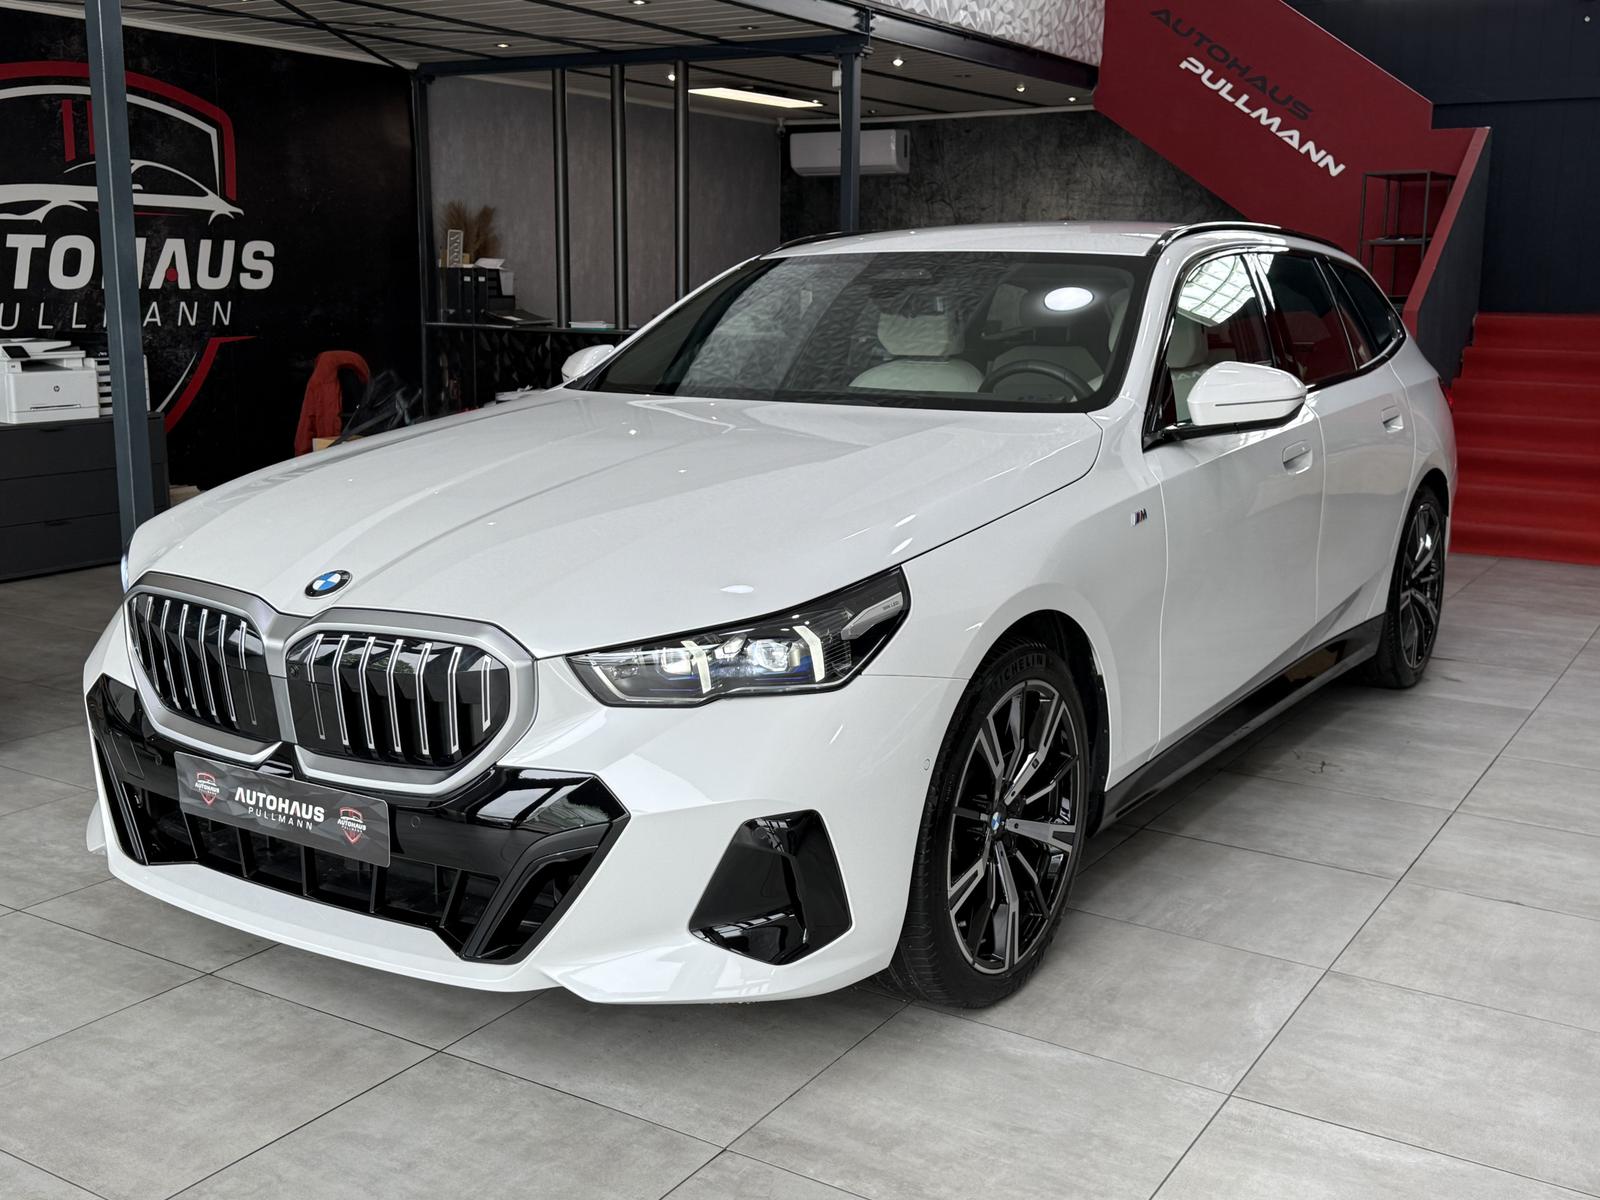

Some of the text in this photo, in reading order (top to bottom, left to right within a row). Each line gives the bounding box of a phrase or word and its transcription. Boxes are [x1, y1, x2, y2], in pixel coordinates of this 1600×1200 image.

[1151, 9, 1313, 121] AUTOHAUS
[1179, 56, 1346, 177] PULLMANN
[0, 301, 232, 331] ULLANN
[234, 786, 325, 823] AUTOHAUS
[248, 806, 313, 831] PULLMANN
